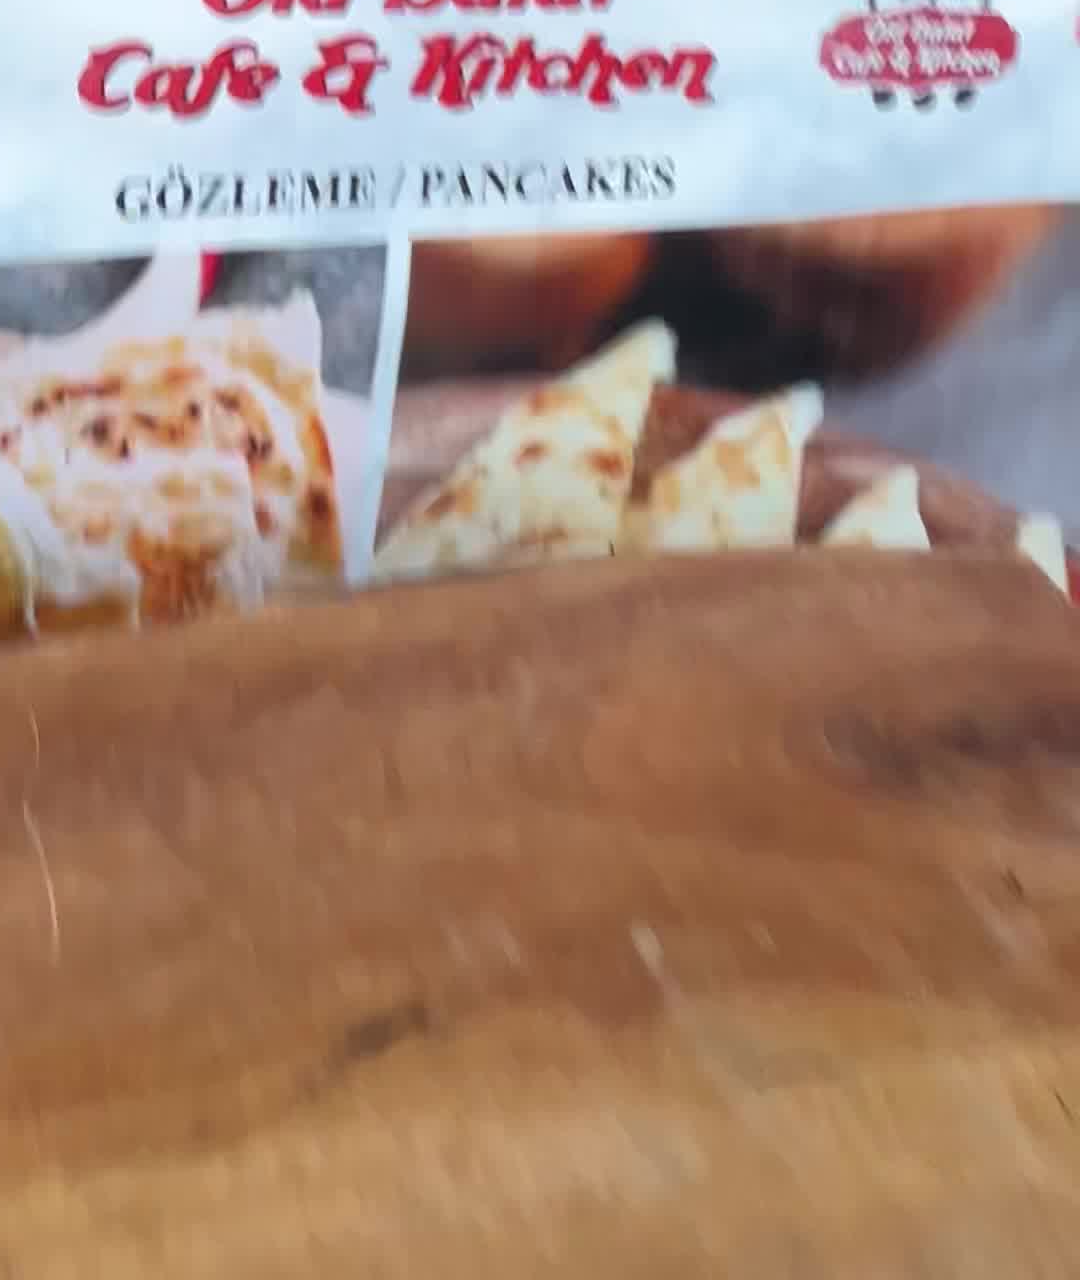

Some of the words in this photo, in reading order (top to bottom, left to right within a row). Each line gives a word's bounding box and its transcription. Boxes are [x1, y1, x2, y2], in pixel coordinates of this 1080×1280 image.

[78, 37, 281, 121] Cafe
[301, 31, 389, 118] &
[409, 31, 717, 112] Kitchen
[115, 162, 376, 219] GÖZLEME
[420, 156, 676, 208] PANCAKES
